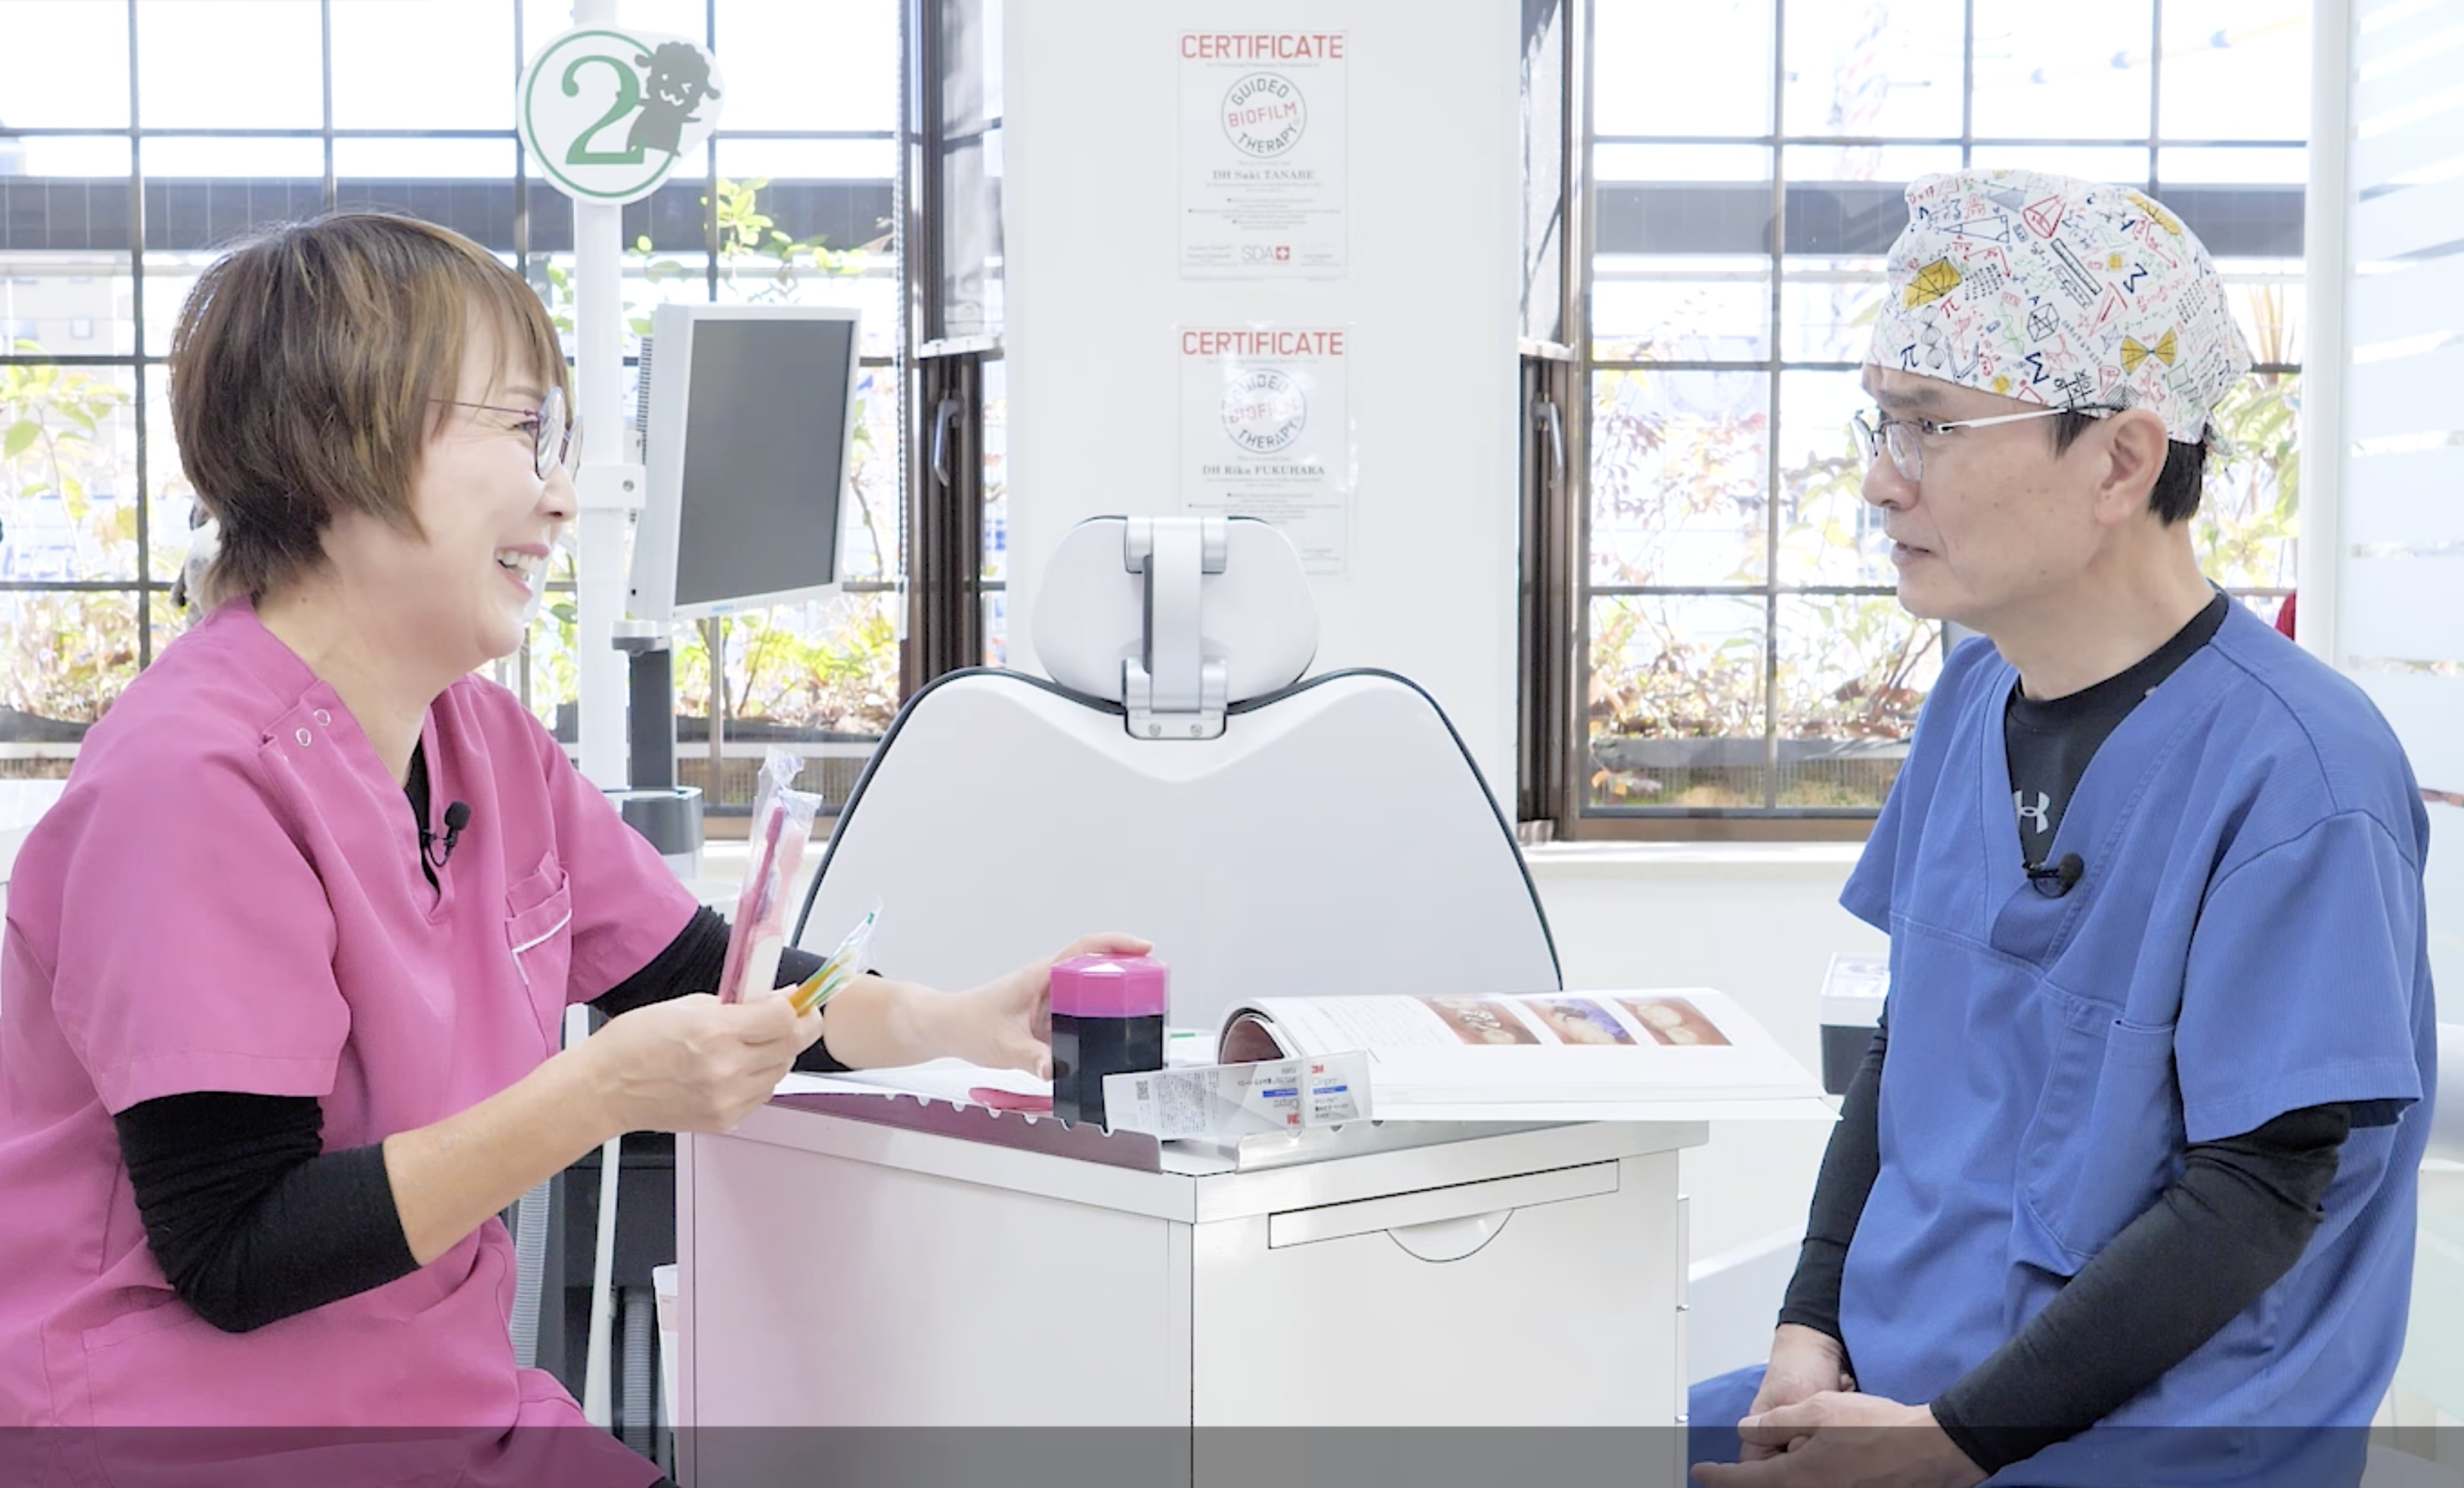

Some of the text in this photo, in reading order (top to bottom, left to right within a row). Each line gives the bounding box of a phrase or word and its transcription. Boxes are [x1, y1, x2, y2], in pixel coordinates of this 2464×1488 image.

[1181, 35, 1343, 58] CERTIFICATE
[1230, 78, 1289, 106] GUIDED
[562, 54, 645, 164] 2
[1228, 102, 1298, 128] BIOFILM
[1237, 123, 1298, 153] THERAPY
[1212, 170, 1315, 180] DH Saki TANABE
[1241, 245, 1274, 262] SDA
[1181, 331, 1343, 355] CERTIFICATE
[1228, 398, 1298, 424] BIOFI
[1237, 420, 1298, 449] THERAPY
[1203, 465, 1326, 475] DH Rika FUKUHARA
